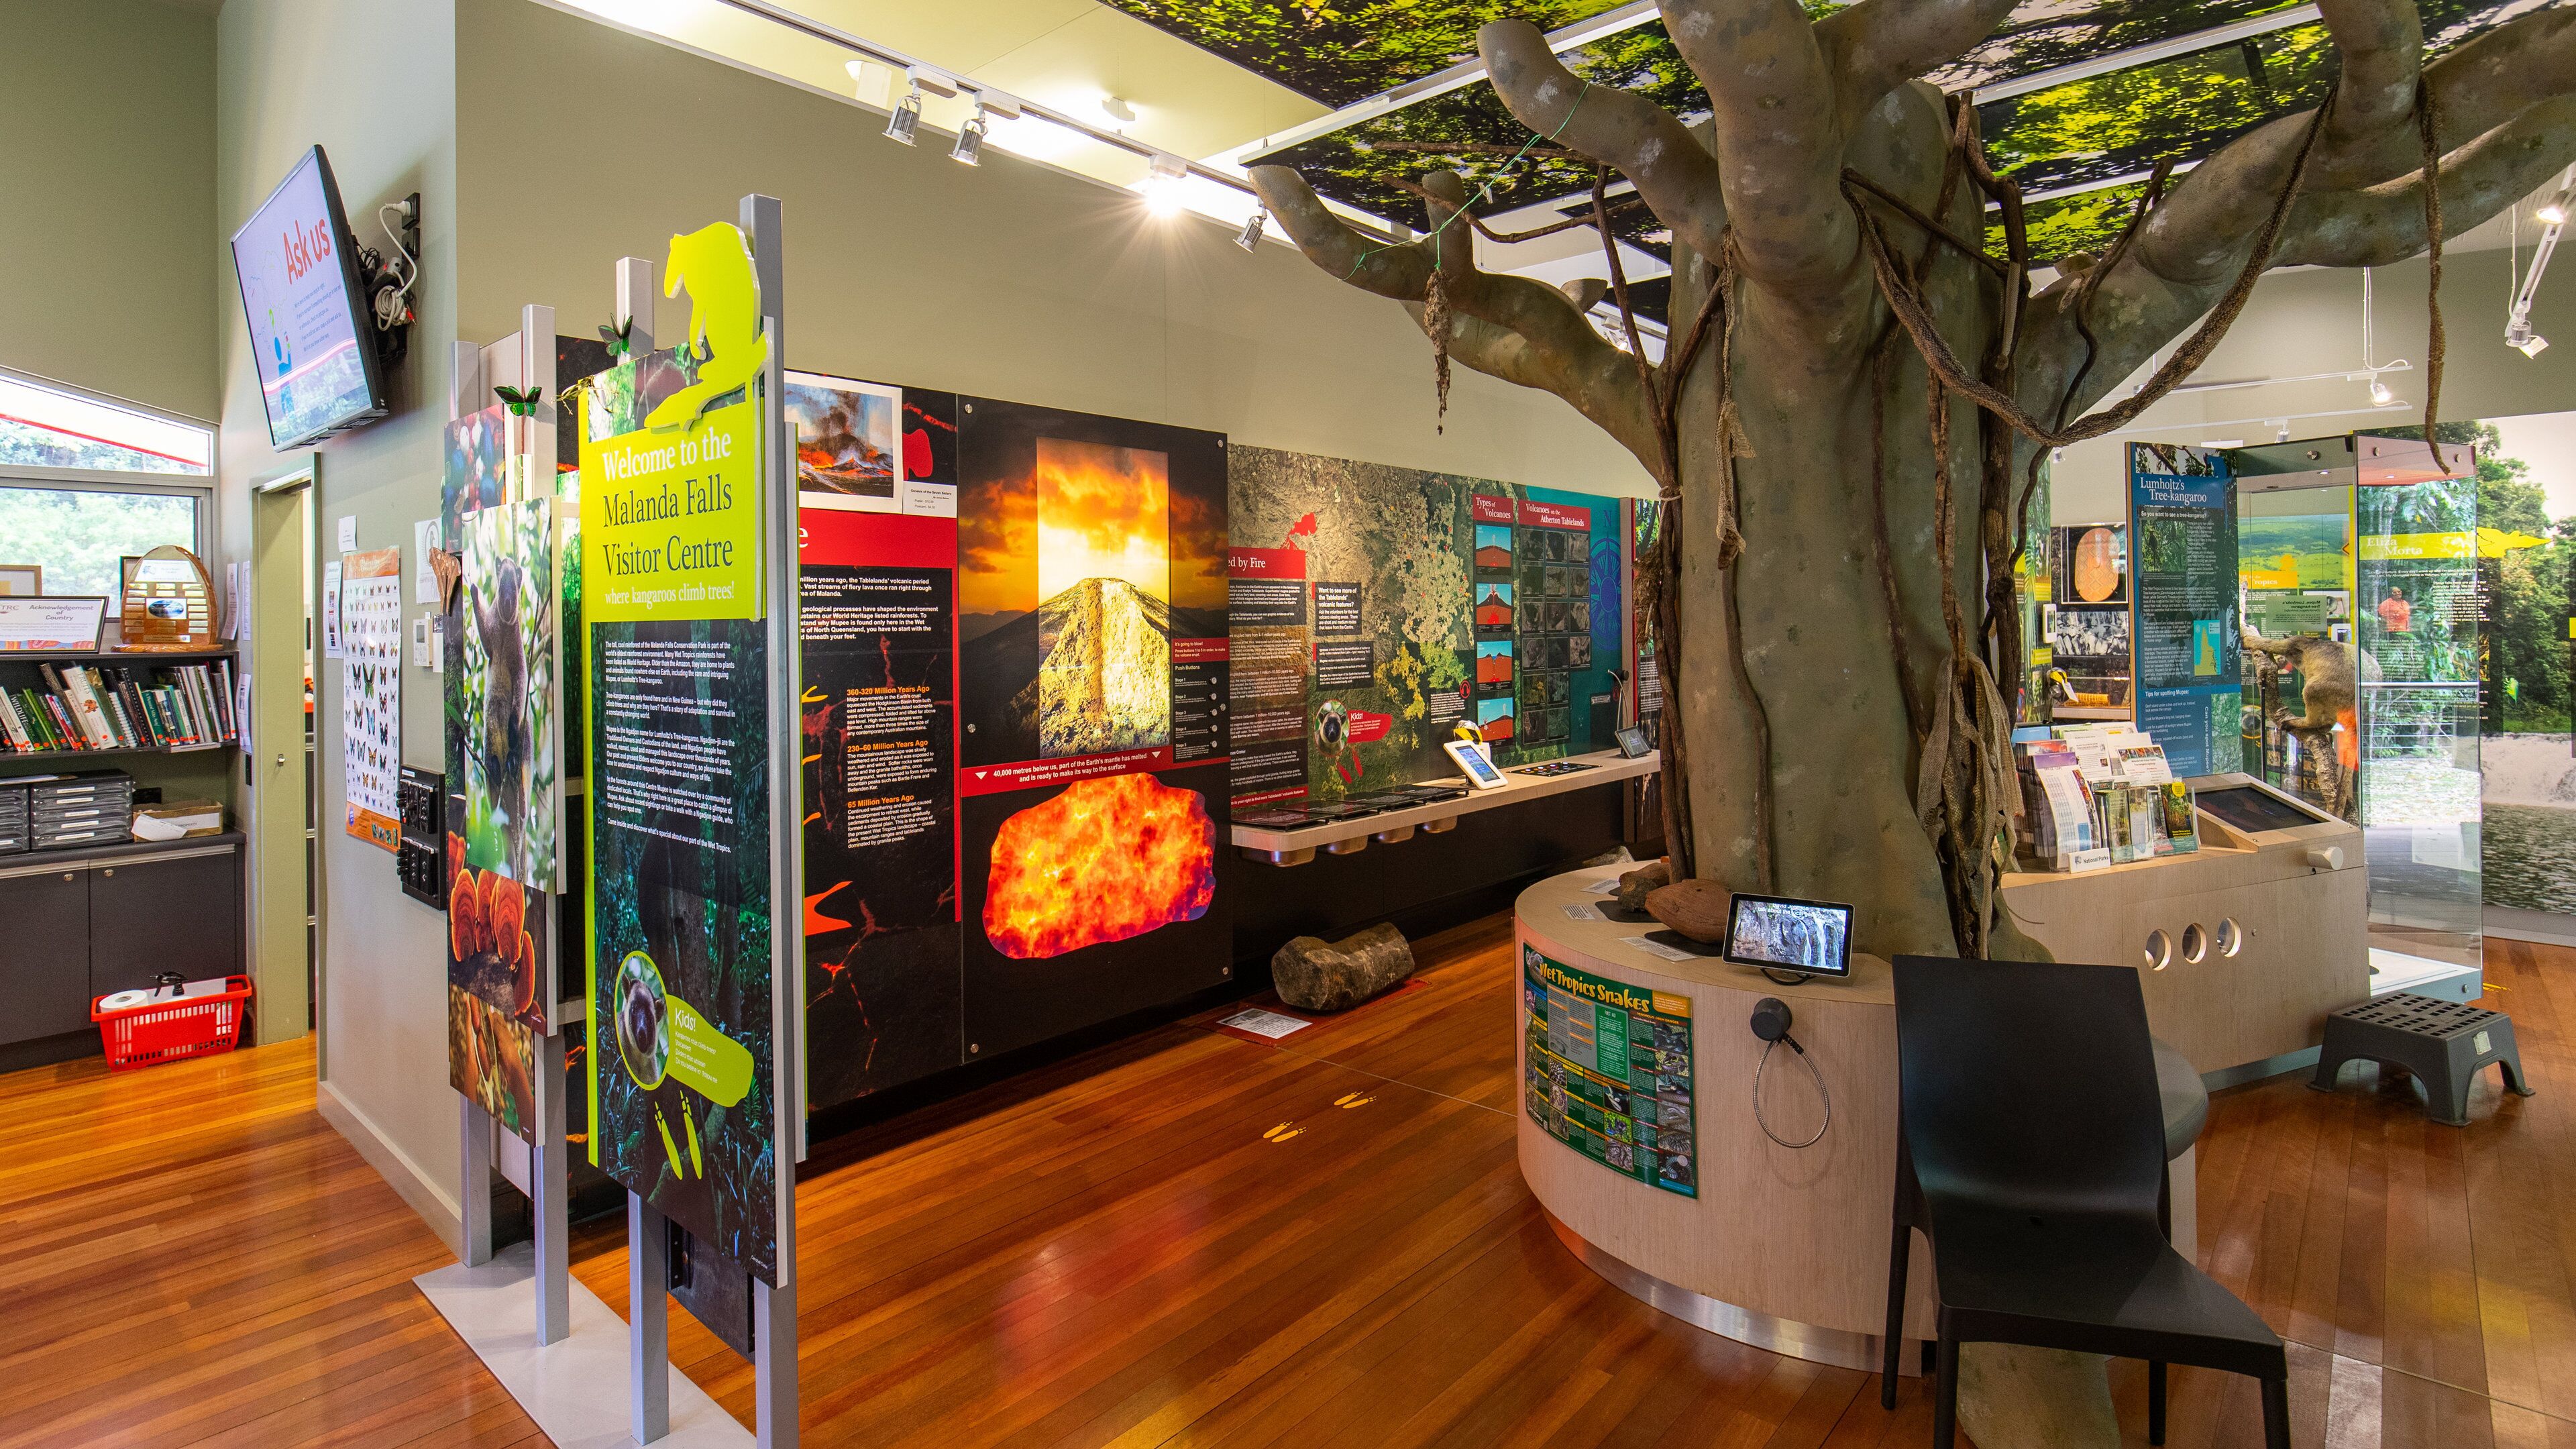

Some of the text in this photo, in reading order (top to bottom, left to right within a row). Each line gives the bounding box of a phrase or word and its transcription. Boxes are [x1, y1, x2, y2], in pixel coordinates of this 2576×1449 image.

[283, 219, 330, 284] Ask us
[602, 427, 731, 482] Welcome to the
[2141, 477, 2184, 490] Lumholtz's
[604, 474, 732, 527] Malanda Falls
[1476, 497, 1491, 508] Types
[2149, 489, 2206, 506] Tree-kangaroo
[1485, 508, 1511, 519] Volcanoes
[1525, 504, 1550, 514] Volcanoes
[1540, 515, 1585, 527] Atherton Tablelands
[1604, 510, 1611, 527] N
[603, 535, 733, 576] Visitor Centre
[2385, 547, 2422, 555] Morta
[1238, 557, 1265, 571] by Fire
[605, 581, 734, 609] where kangaroos climb trees!
[11, 696, 28, 724] WILDLIFE
[1351, 712, 1362, 721] Kids!
[994, 769, 1012, 777] 40,000
[858, 799, 879, 807] Million
[675, 1008, 696, 1032] Kids!
